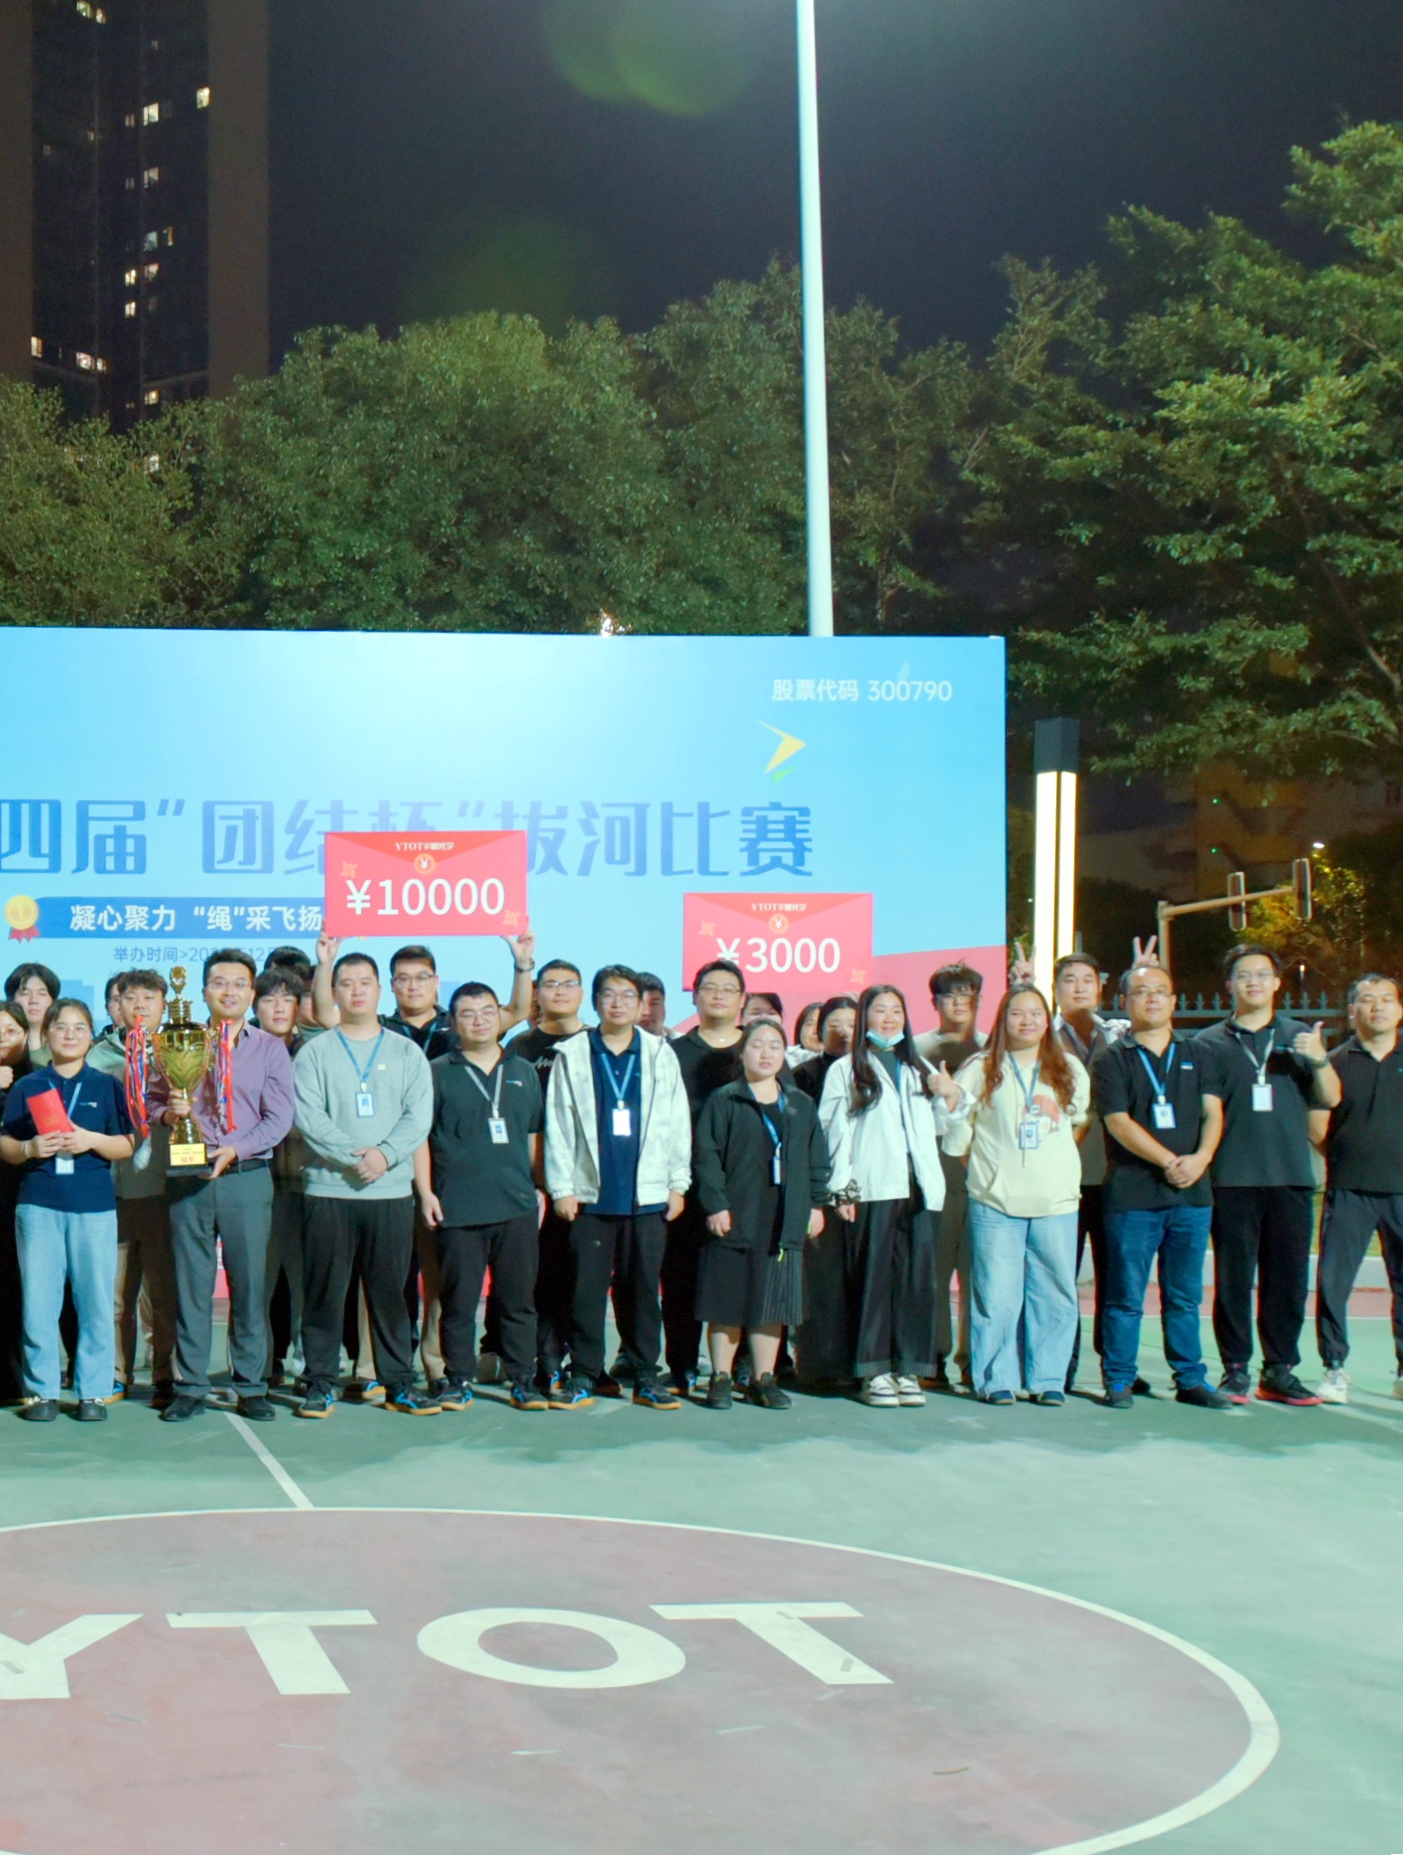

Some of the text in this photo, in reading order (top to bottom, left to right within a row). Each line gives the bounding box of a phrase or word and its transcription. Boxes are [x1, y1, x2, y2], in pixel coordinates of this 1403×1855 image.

[772, 678, 953, 702] 股票代码 300790
[346, 878, 505, 915] ¥10000
[70, 904, 176, 931] 凝心聚力
[716, 937, 840, 973] ¥3000
